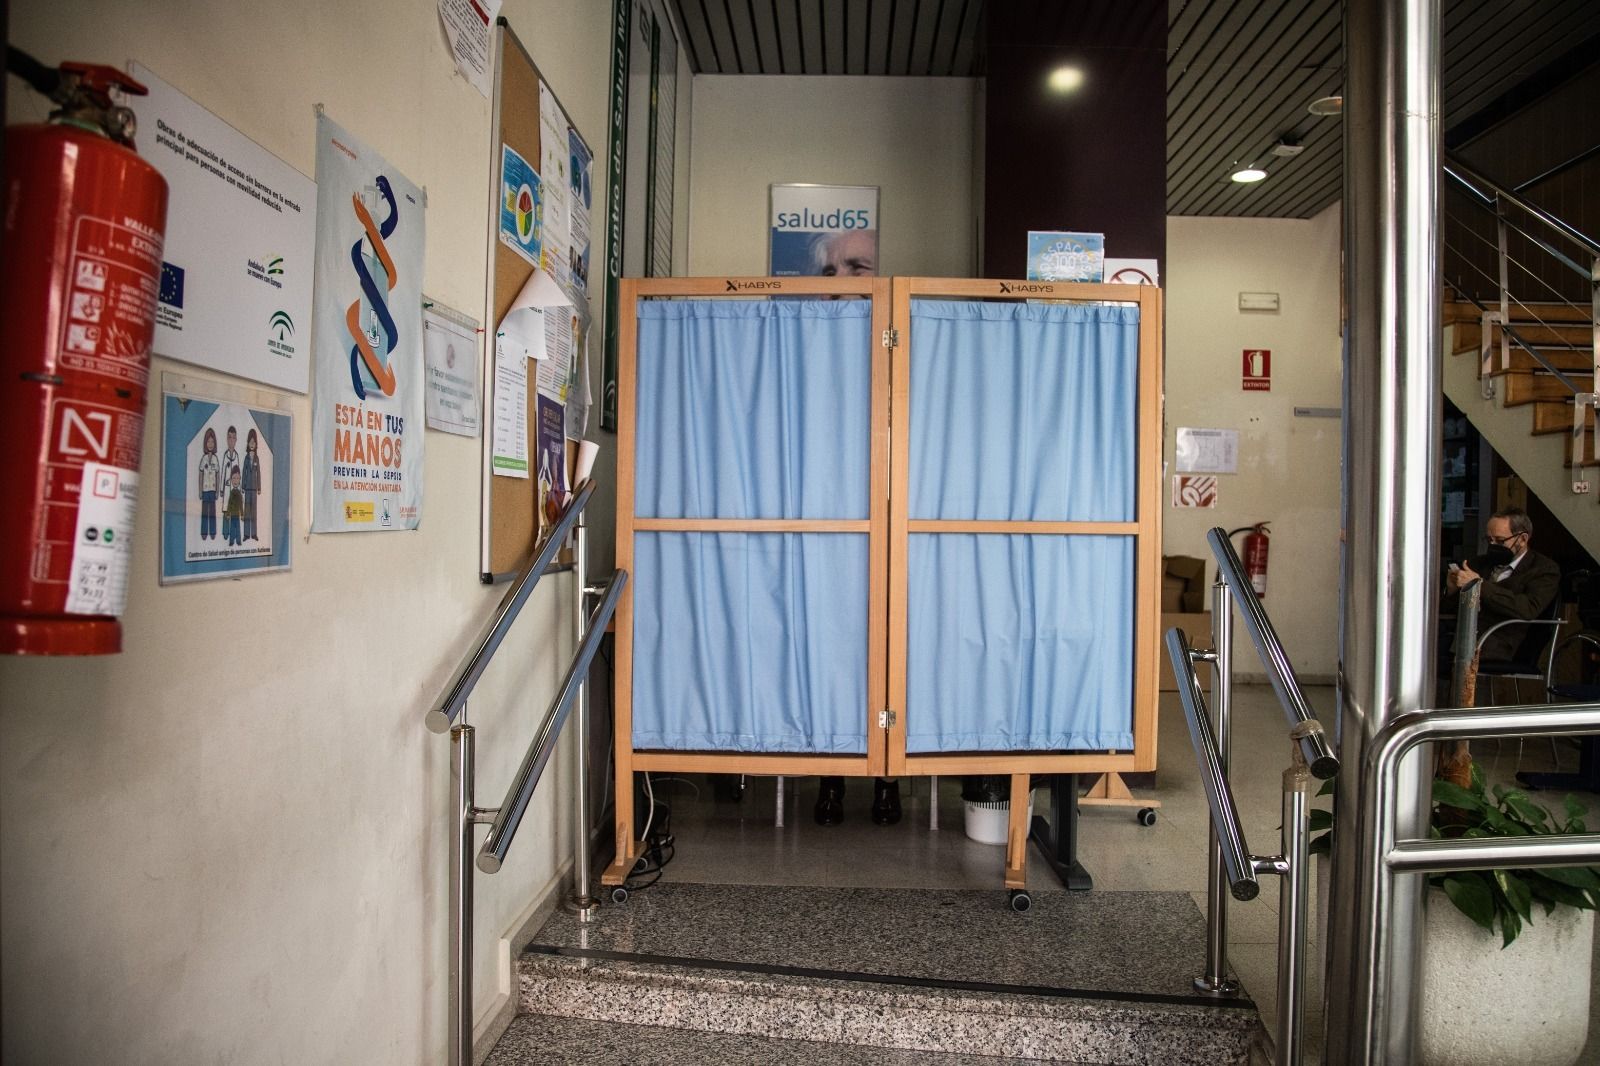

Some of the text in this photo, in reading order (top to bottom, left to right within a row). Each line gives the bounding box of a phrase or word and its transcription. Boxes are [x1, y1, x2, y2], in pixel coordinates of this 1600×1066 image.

[614, 49, 625, 129] Salud
[156, 119, 301, 213] Obras de adecuación de acceso sin barrera en la entrada
[156, 133, 185, 156] principal
[185, 151, 199, 165] para
[200, 160, 225, 180] personas
[226, 175, 236, 186] con
[236, 181, 261, 201] movilidad
[612, 139, 622, 173] de
[609, 184, 622, 277] Centro
[777, 207, 869, 230] salud65
[737, 281, 782, 289] HABYS
[1011, 284, 1054, 293] HABYS
[335, 402, 404, 436] ESTÁ EN TUS
[333, 428, 402, 469] MANOS
[333, 465, 402, 481] PREVENIR LA SEPSIS
[333, 480, 342, 490] EN
[342, 481, 349, 491] LA
[378, 483, 402, 494] SANITARIA
